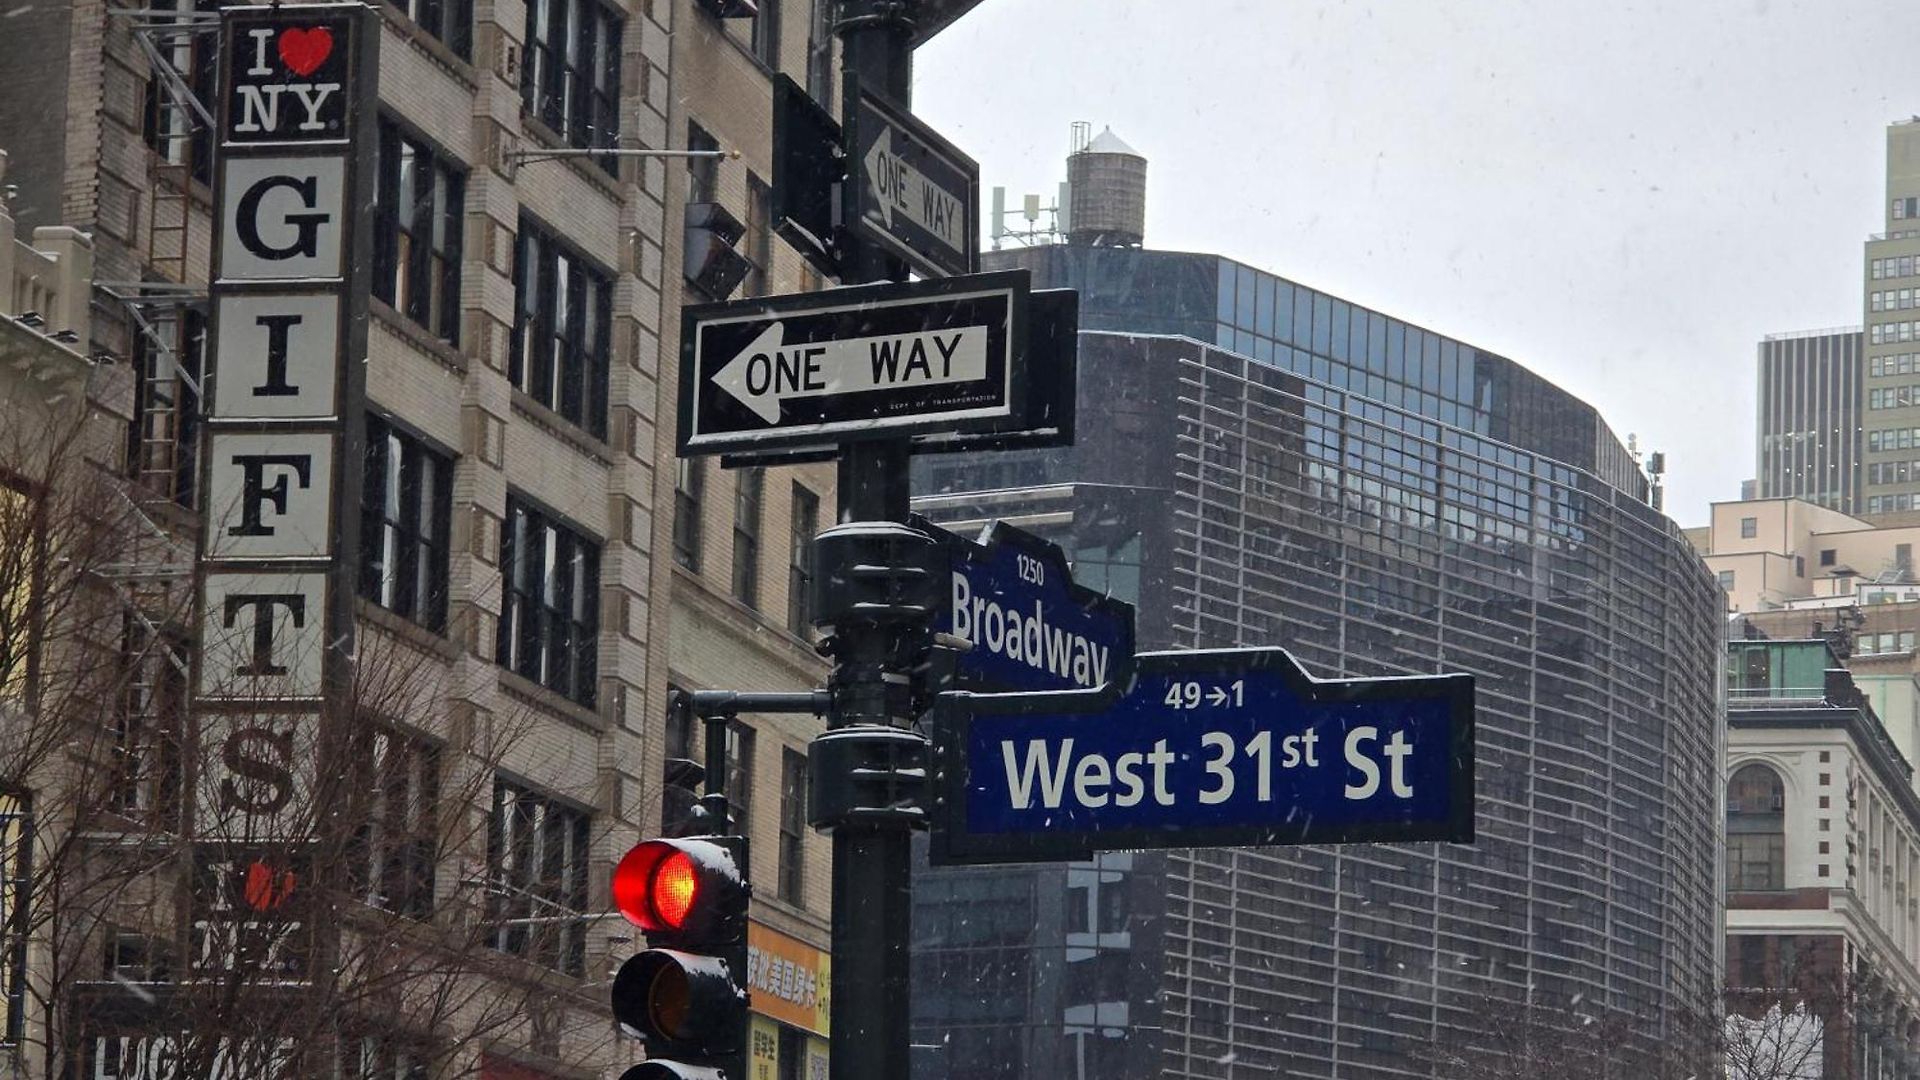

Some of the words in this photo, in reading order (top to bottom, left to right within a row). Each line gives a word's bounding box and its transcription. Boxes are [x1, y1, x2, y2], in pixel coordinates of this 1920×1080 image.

[247, 28, 275, 76] I
[877, 151, 907, 210] ONE
[922, 181, 955, 239] WAY
[745, 347, 826, 396] ONE
[870, 333, 962, 384] WAY
[221, 175, 330, 816] GIFTS
[1017, 554, 1044, 586] 1250
[952, 571, 1108, 687] Broadway
[1001, 738, 1175, 809] West
[1199, 727, 1319, 804] 31st
[1344, 726, 1414, 800] St
